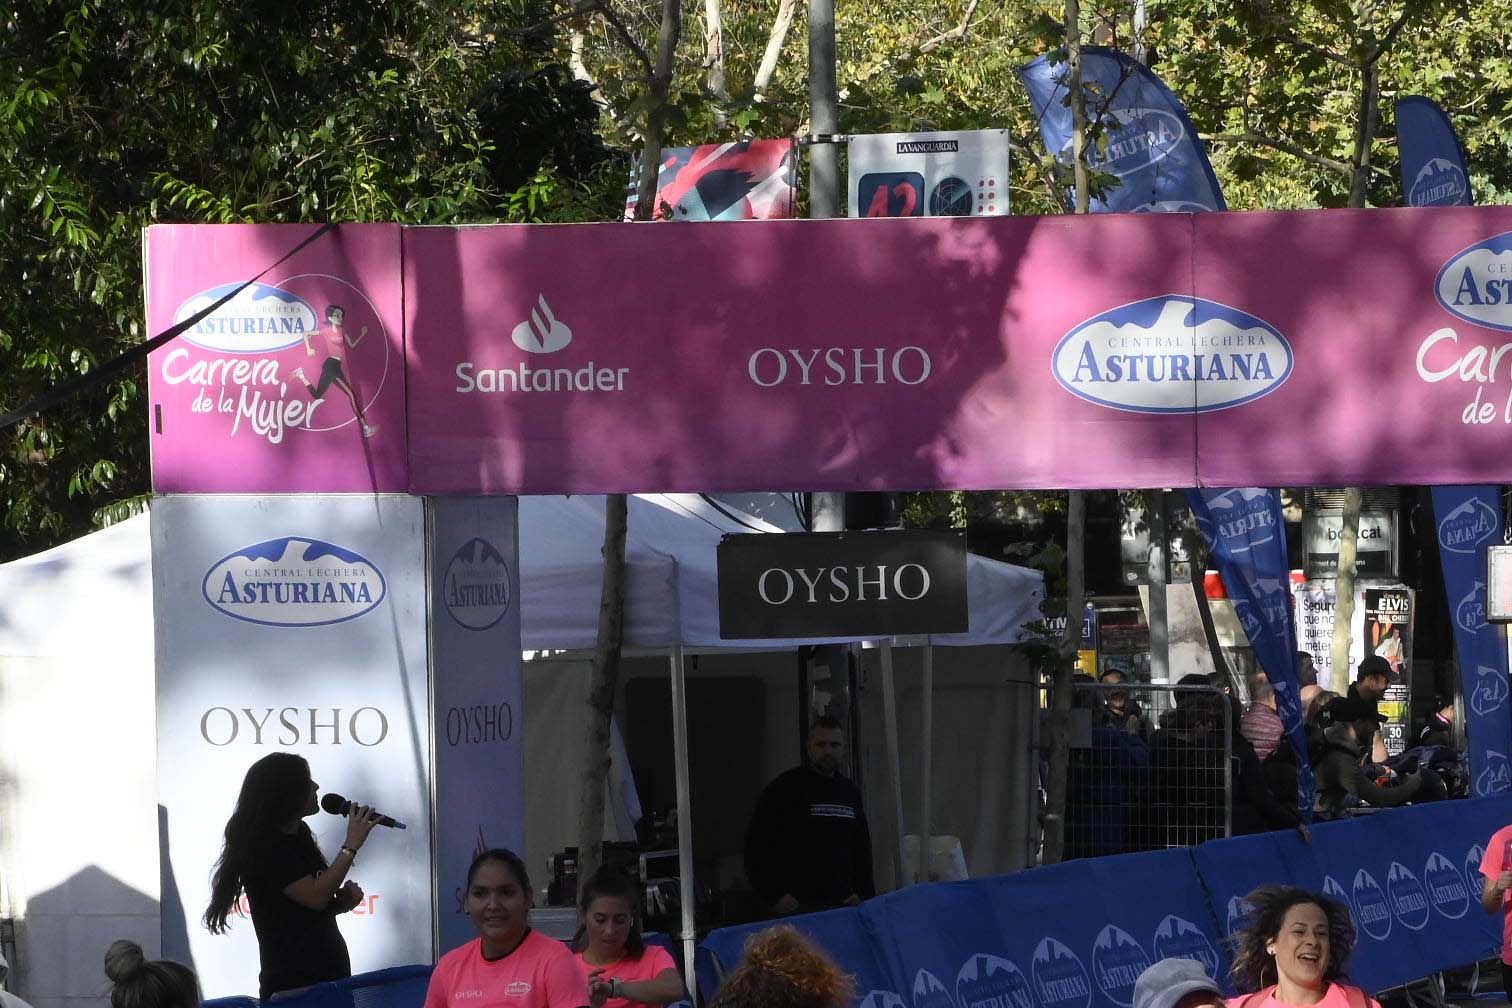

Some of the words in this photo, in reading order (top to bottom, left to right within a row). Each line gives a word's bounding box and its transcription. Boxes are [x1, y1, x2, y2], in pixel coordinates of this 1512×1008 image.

[1108, 336, 1184, 347] CENTRAL
[1191, 335, 1266, 347] LECHERA
[162, 348, 280, 384] Carrera
[456, 361, 629, 393] Santander
[748, 346, 931, 387] OYSHO
[1071, 340, 1274, 383] ASTURIANA
[192, 388, 213, 412] de
[218, 388, 234, 412] la
[230, 381, 325, 444] Mujer
[1462, 386, 1496, 424] de
[216, 570, 373, 604] ASTURIANA
[244, 568, 301, 577] CENTRAL
[308, 568, 366, 577] LECHERA
[758, 563, 930, 605] OYSHO
[450, 573, 507, 608] ASTURIANA
[1379, 598, 1409, 611] ELVIS
[1304, 616, 1320, 628] que
[1305, 627, 1335, 640] quiere
[200, 707, 389, 746] OYSHO
[446, 703, 512, 746] OYSHO
[1389, 728, 1401, 738] 30
